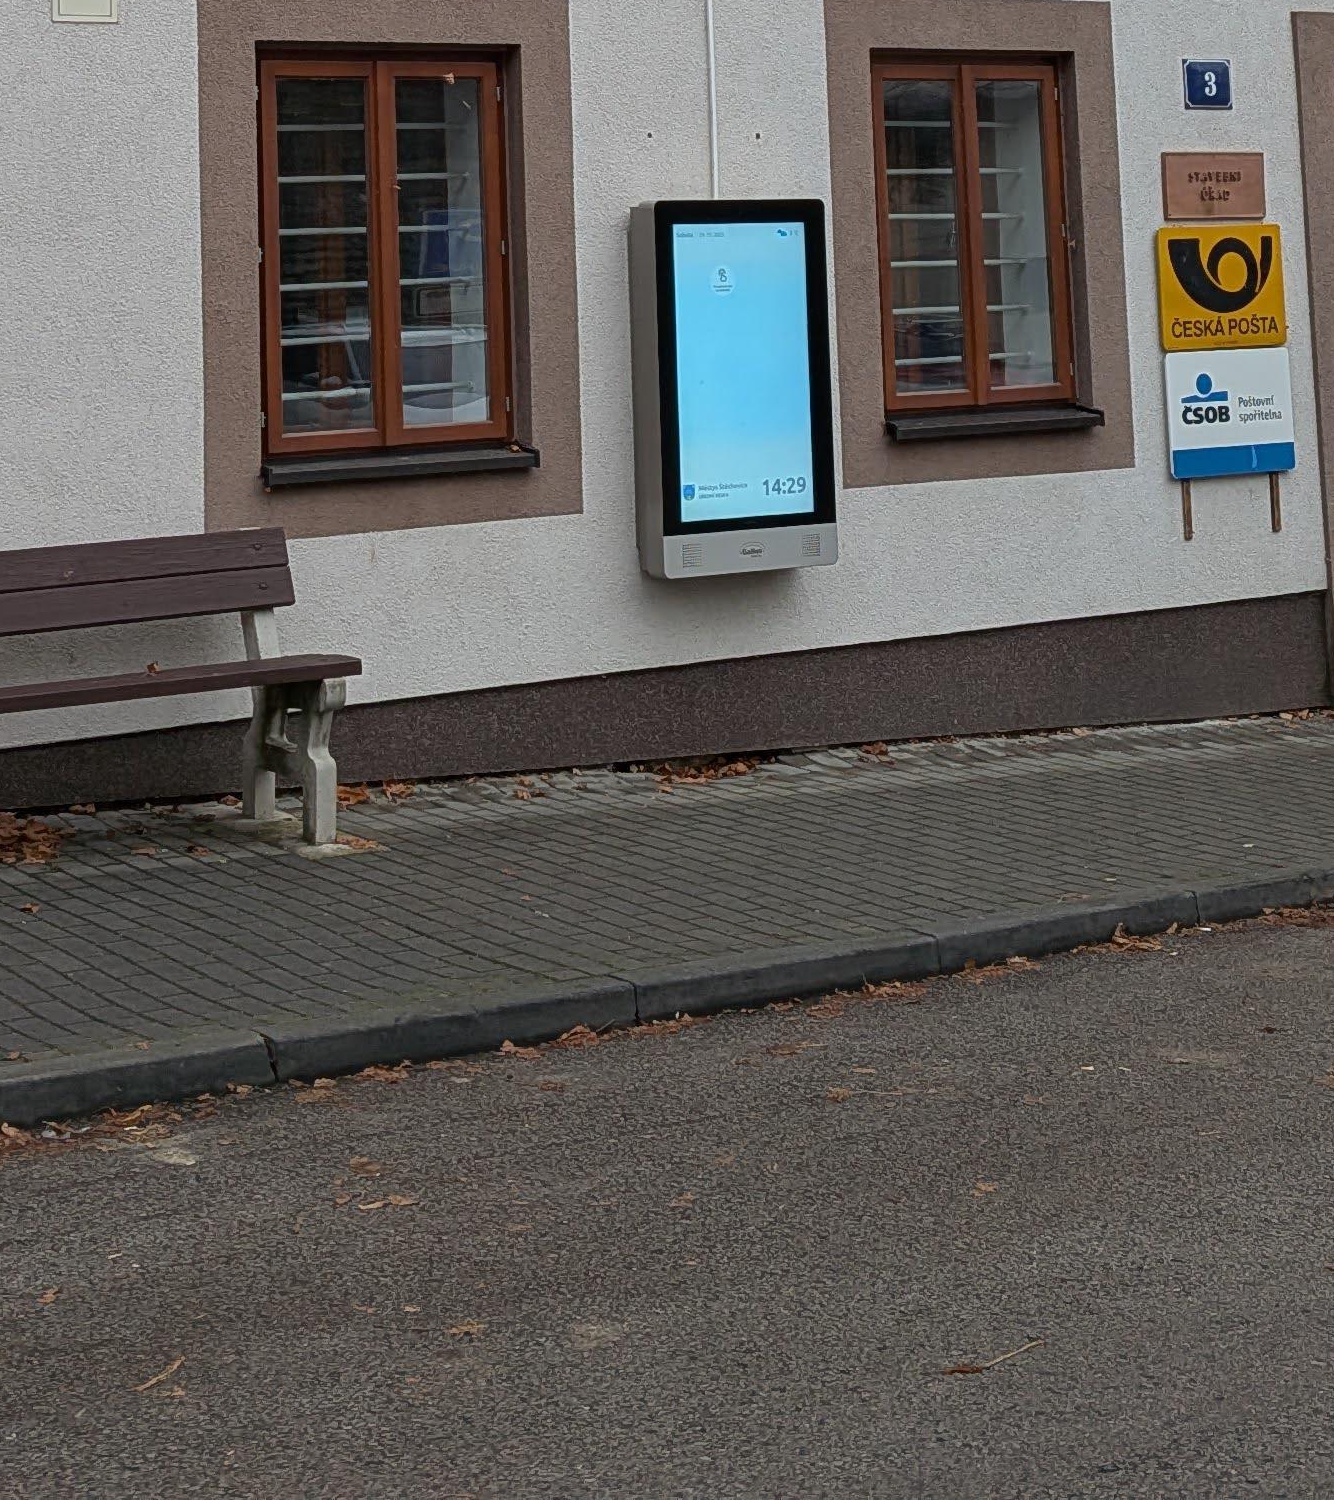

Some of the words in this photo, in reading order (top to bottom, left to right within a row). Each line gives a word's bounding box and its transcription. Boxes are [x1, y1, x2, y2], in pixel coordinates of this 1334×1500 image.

[1204, 71, 1218, 97] 3
[1171, 316, 1225, 339] ČESKÁ
[1228, 314, 1279, 336] POŠTA
[1238, 395, 1275, 408] Poštovní
[1182, 405, 1231, 425] ČSOB
[1238, 409, 1283, 424] spořitelna
[762, 476, 807, 496] 14:29
